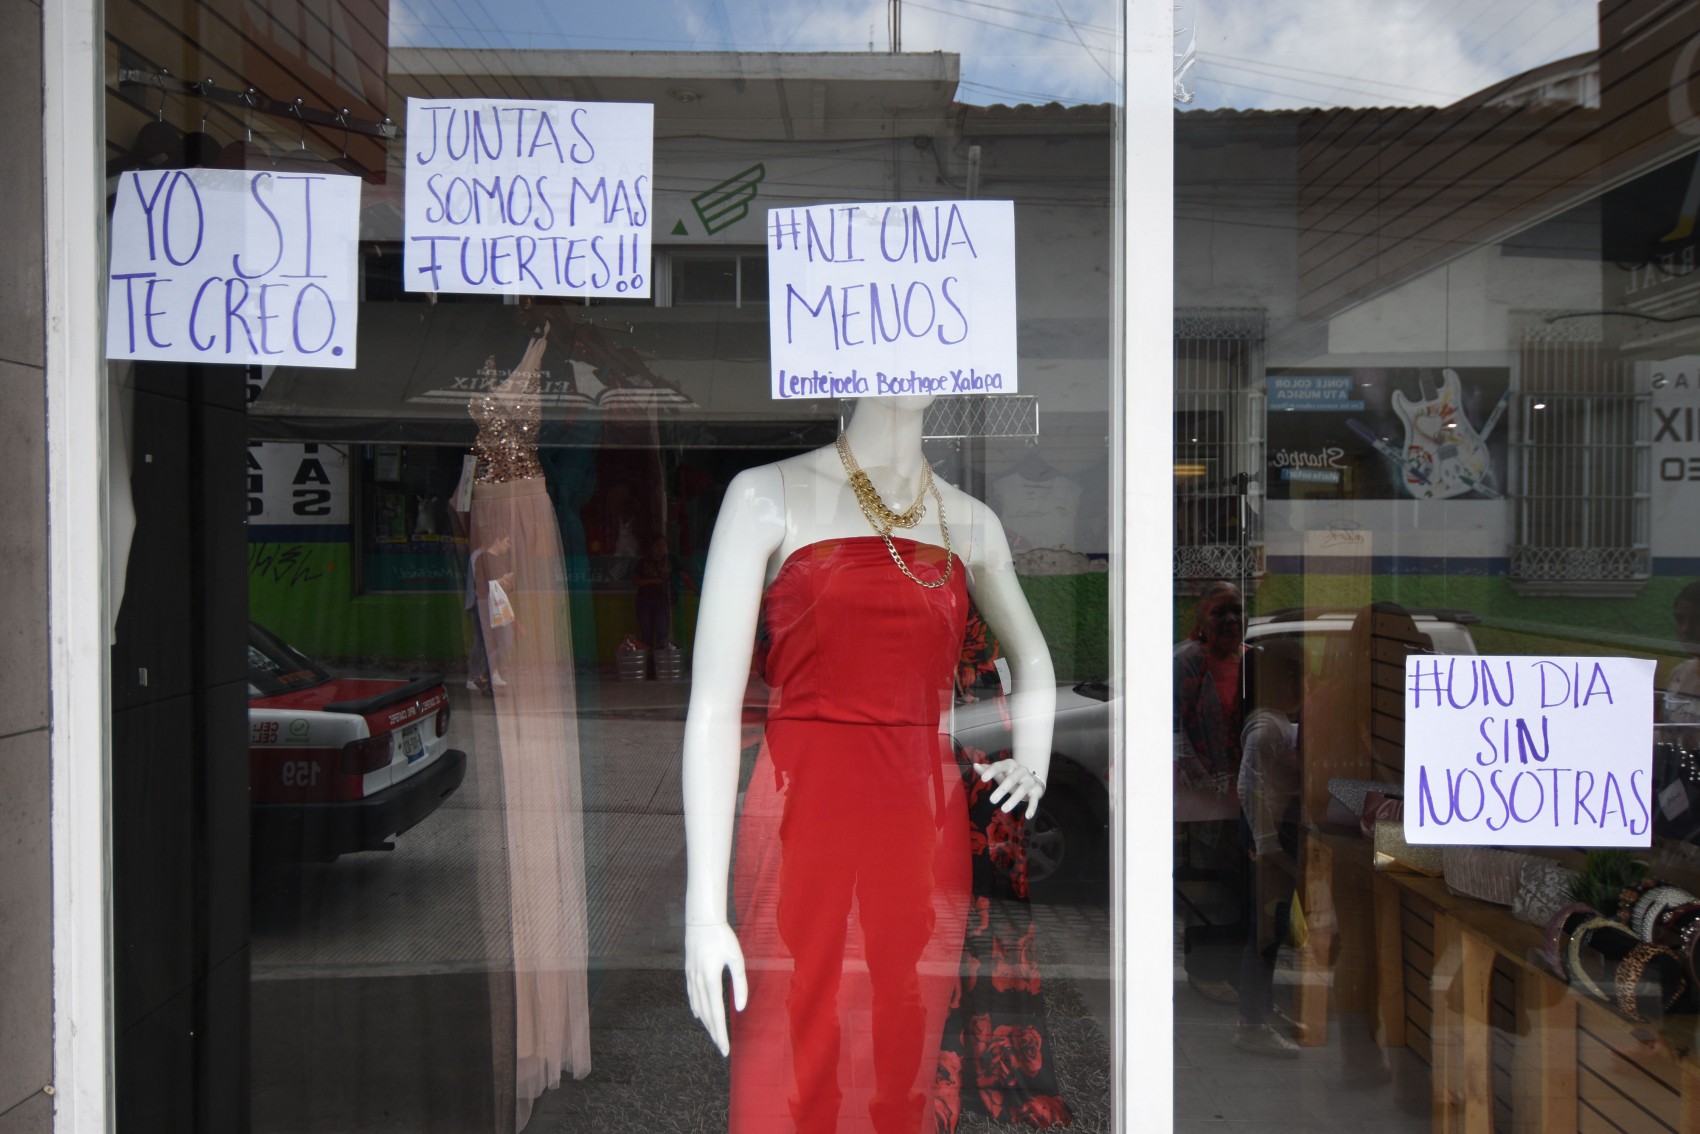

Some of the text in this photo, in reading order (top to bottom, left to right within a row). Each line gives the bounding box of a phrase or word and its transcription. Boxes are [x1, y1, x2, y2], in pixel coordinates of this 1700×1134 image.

[417, 106, 595, 165] JUNTAS
[133, 171, 327, 279] YO SI
[426, 175, 555, 229] SOMOS
[570, 176, 648, 227] MAS
[769, 204, 978, 263] #NI UNA
[411, 234, 645, 293] FUERTES!!
[111, 272, 345, 357] TE CREO.
[786, 276, 969, 350] MENOS
[949, 368, 1003, 392] Xalapa
[1408, 658, 1614, 710] #UN DIA
[1476, 715, 1550, 767] SIN
[1418, 765, 1650, 836] NOSOTRAS
